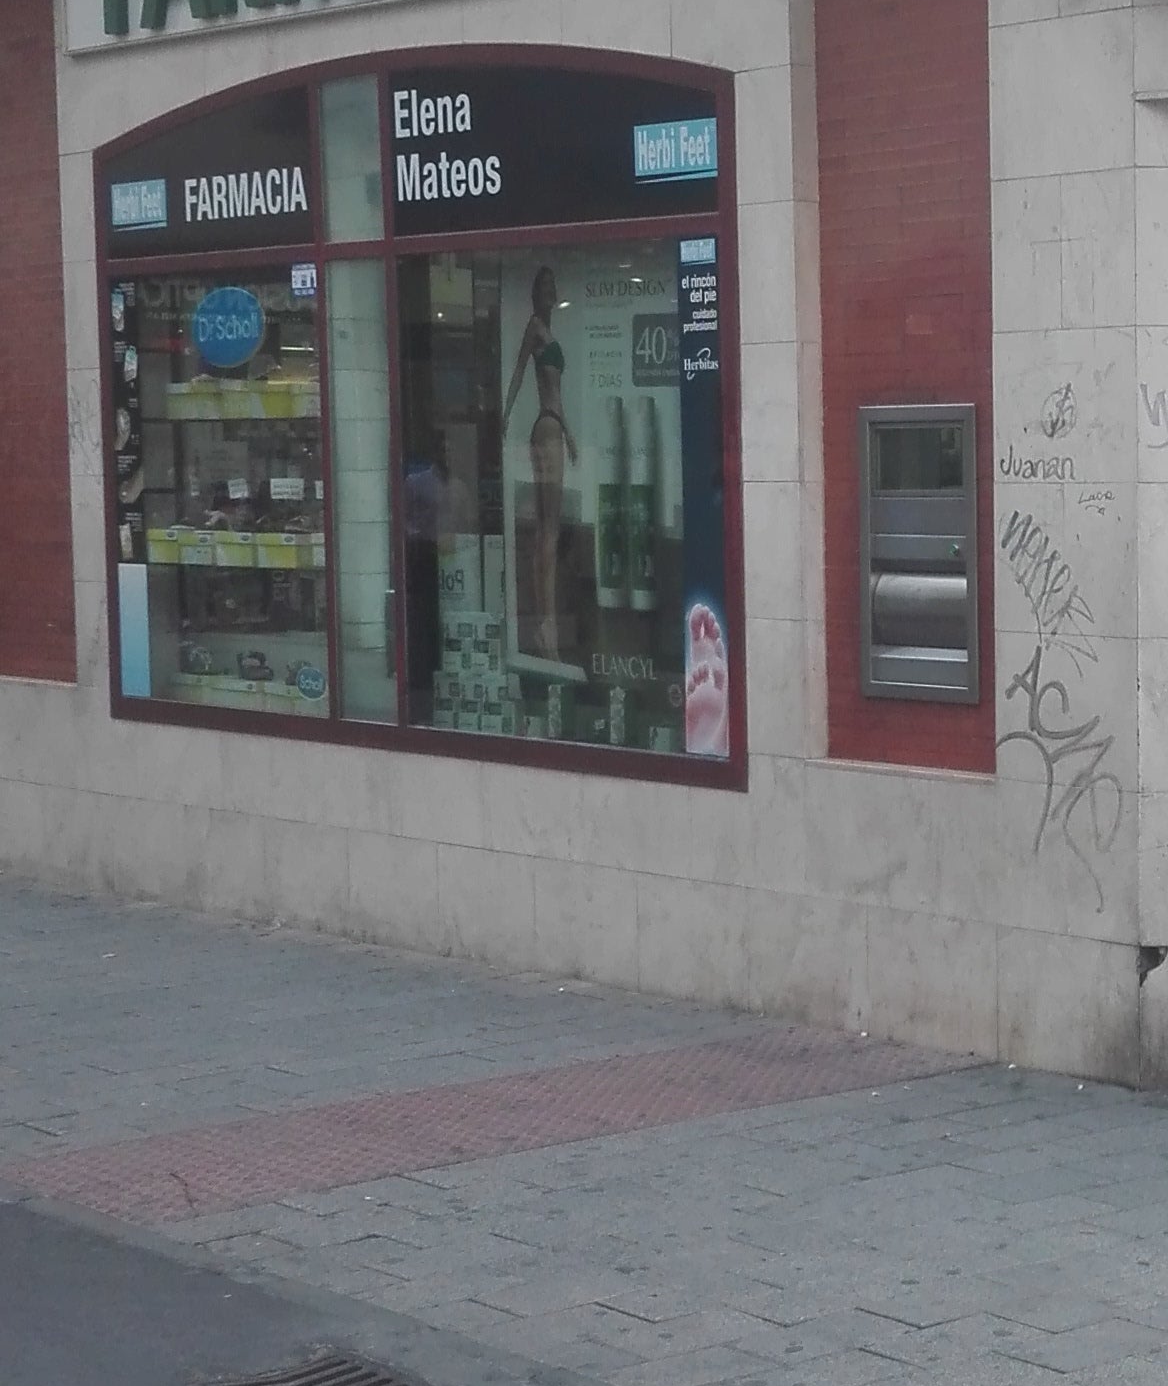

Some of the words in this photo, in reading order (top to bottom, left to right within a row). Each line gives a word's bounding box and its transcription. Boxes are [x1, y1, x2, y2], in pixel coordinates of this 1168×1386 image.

[393, 89, 472, 140] Elena
[636, 128, 676, 170] Herbi
[679, 124, 712, 167] Feet
[184, 166, 308, 222] FARMACIA
[396, 151, 502, 202] Mateos
[681, 275, 690, 289] el
[690, 272, 717, 288] rincón
[690, 289, 703, 303] del
[704, 287, 717, 304] pie
[591, 652, 658, 681] ELANCYL
